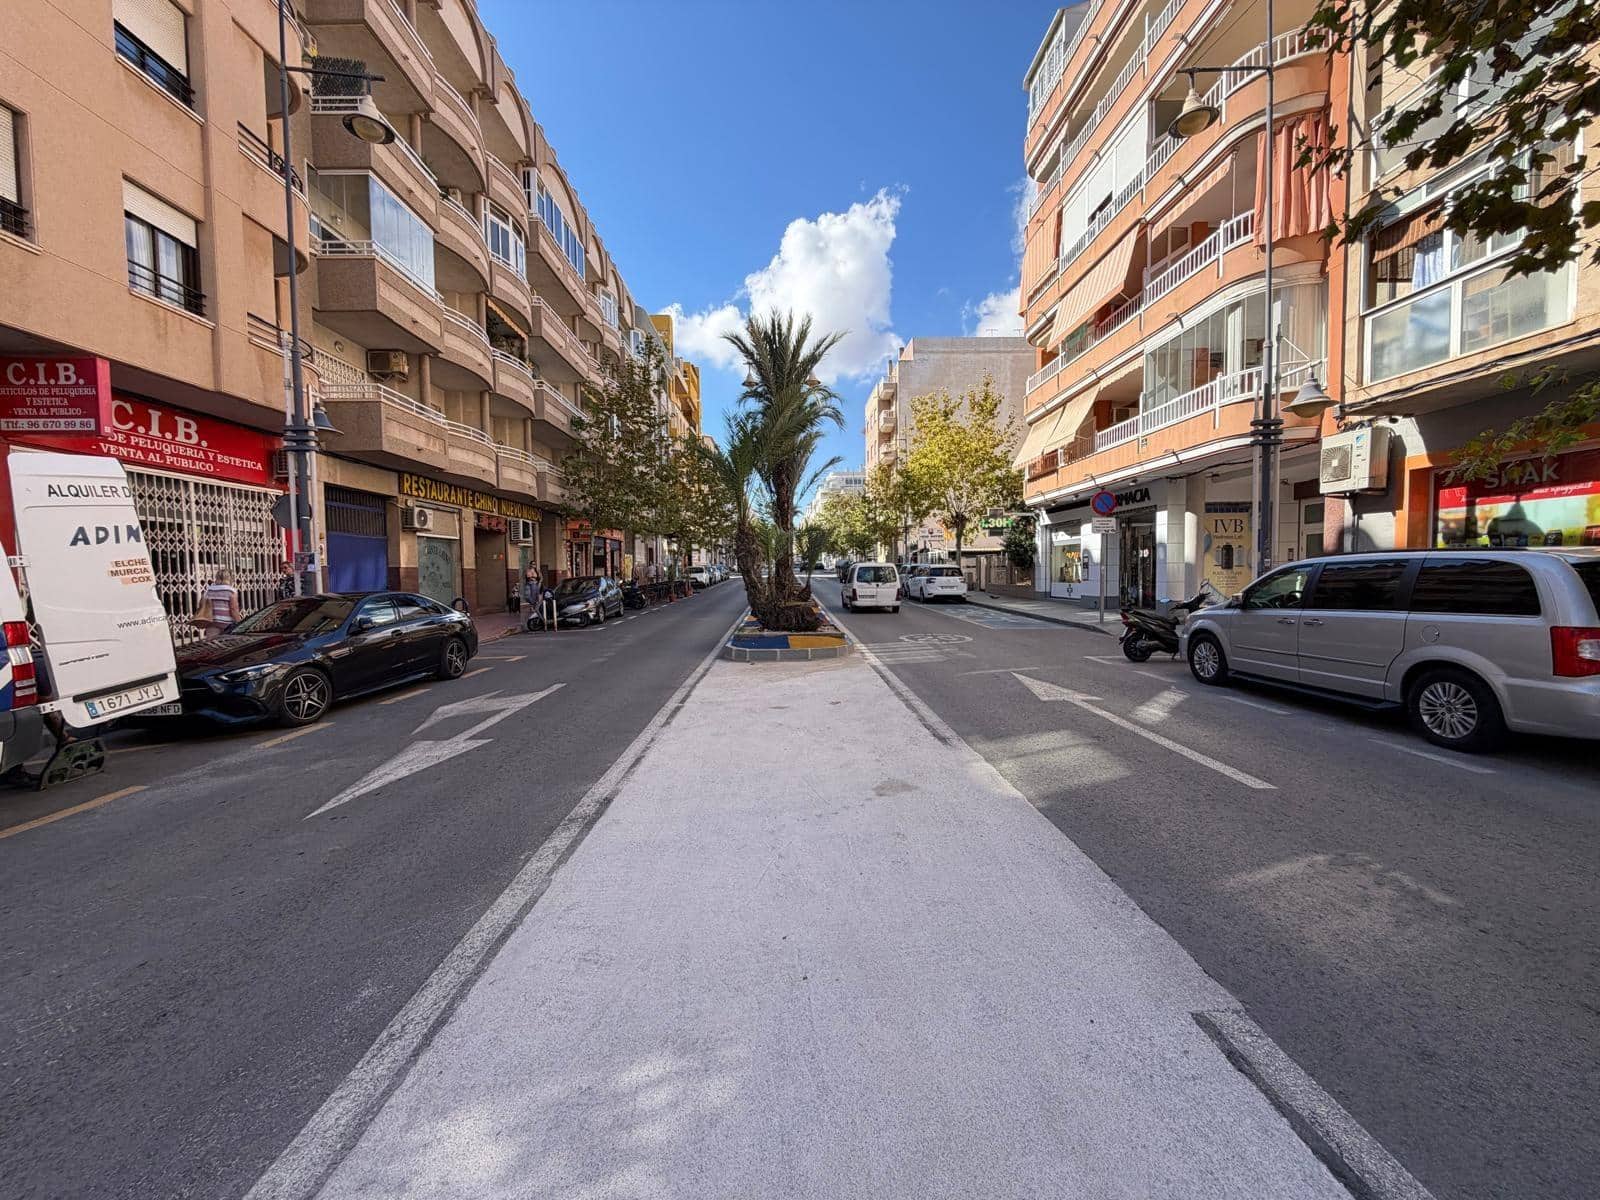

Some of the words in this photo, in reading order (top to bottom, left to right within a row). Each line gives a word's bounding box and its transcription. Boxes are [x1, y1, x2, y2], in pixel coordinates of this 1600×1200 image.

[6, 362, 85, 385] C.I.B.
[0, 387, 37, 395] RTICULOS
[39, 387, 49, 395] DE
[51, 387, 96, 397] PELUQUERIA
[26, 398, 31, 406] Y
[33, 398, 69, 406] ESTETICA
[13, 407, 38, 416] VENTA
[39, 407, 49, 416] AL
[50, 407, 82, 416] PUBLICO
[27, 421, 40, 429] 96
[42, 421, 61, 429] 670
[64, 421, 77, 429] 99
[79, 421, 92, 429] 86
[111, 400, 208, 448] C.I.B.
[99, 442, 145, 461] VENTA
[148, 452, 165, 464] AL
[166, 456, 214, 473] PUBLICO
[130, 436, 205, 460] PELUQUERIA
[207, 452, 216, 462] Y
[217, 454, 263, 472] ESTETICA
[48, 484, 120, 498] ALQUILER
[122, 486, 135, 498] D
[403, 473, 473, 507] RESTAURANTE
[1214, 519, 1244, 533] IVB
[114, 558, 149, 568] ELCHE
[110, 567, 150, 577] MURCIA
[131, 576, 152, 584] COX
[98, 694, 132, 712] 1671
